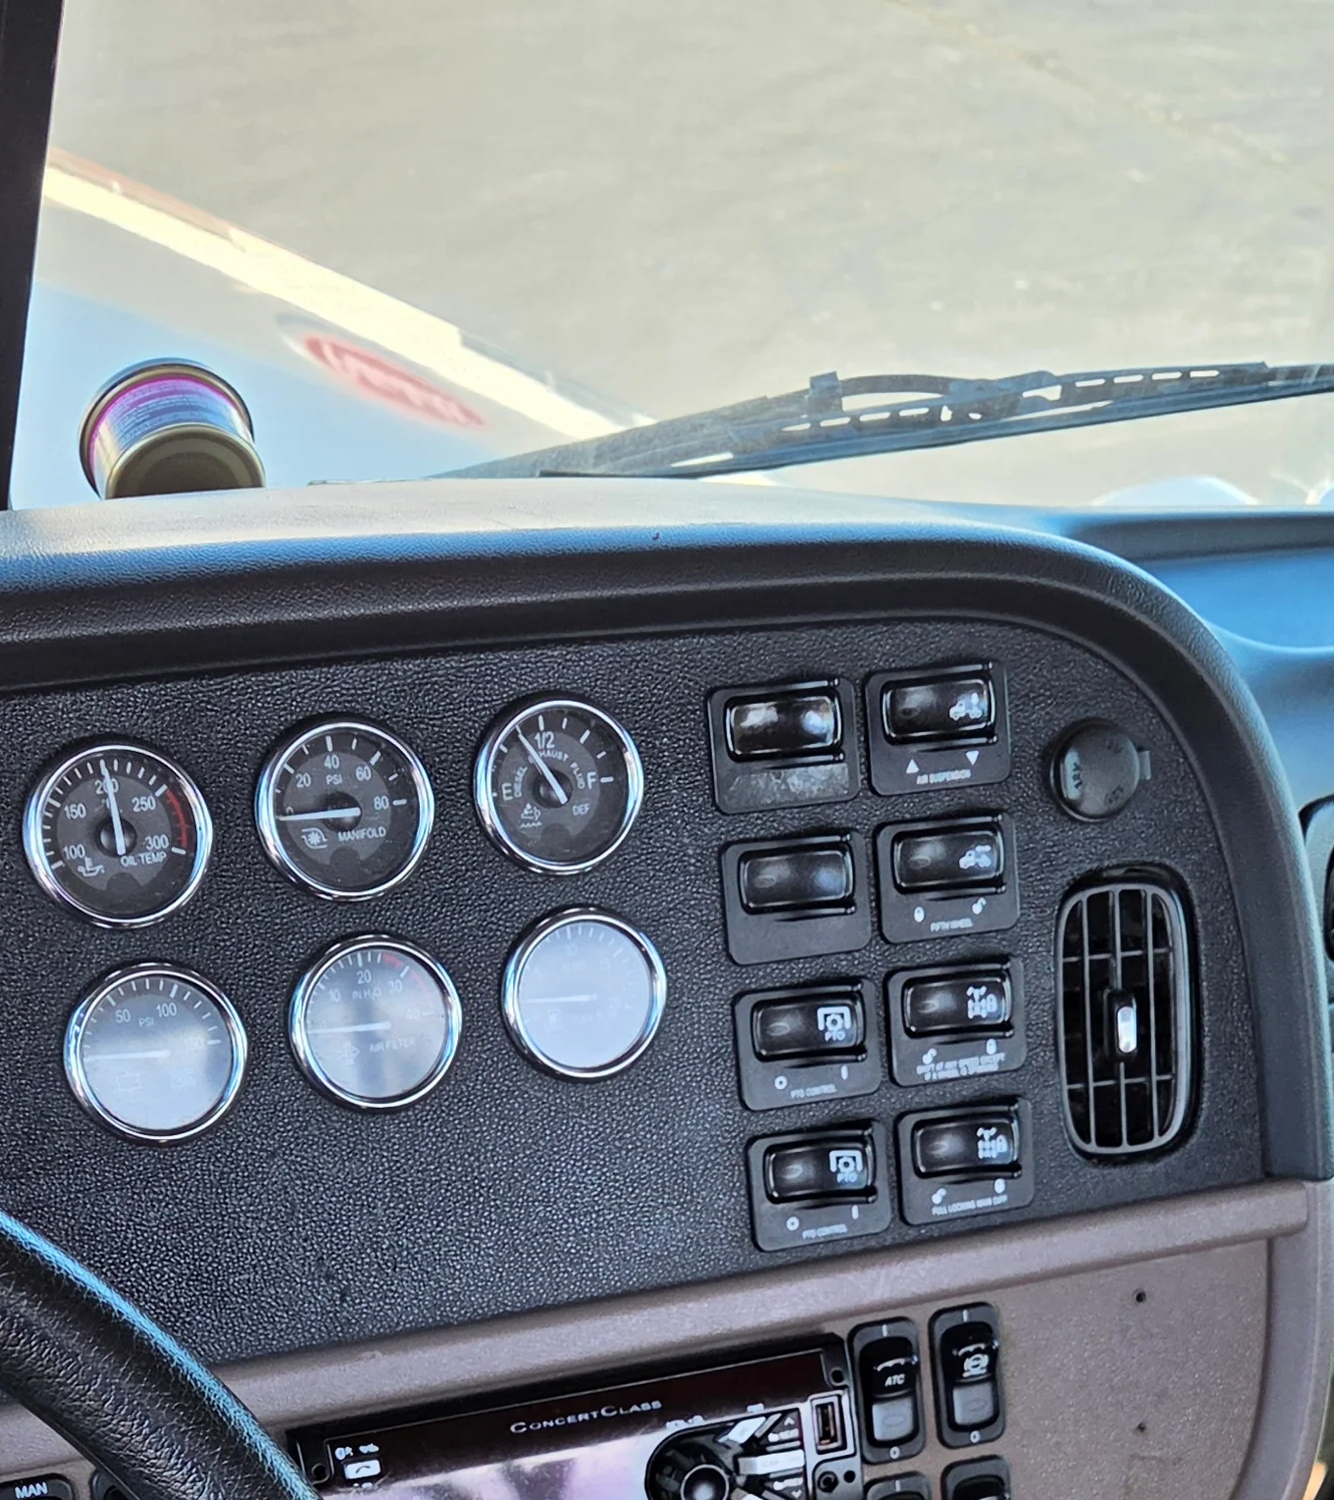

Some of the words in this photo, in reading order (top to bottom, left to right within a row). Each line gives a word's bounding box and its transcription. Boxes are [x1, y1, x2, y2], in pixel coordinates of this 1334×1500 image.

[324, 754, 340, 769] 40
[528, 750, 569, 764] EHAUST
[295, 772, 312, 789] 20
[326, 774, 343, 785] PSI
[355, 766, 372, 781] 60
[587, 771, 598, 790] F
[501, 782, 513, 801] E
[131, 795, 156, 812] 250
[374, 795, 390, 810] 80
[572, 803, 591, 816] DEF
[64, 803, 87, 819] 150
[144, 834, 170, 850] 300
[337, 826, 386, 842] MANIFOLD
[63, 844, 86, 860] 100
[120, 853, 138, 867] OIL
[139, 851, 167, 865] TEMP
[356, 969, 372, 985] 20
[115, 1008, 131, 1024] 50
[156, 1002, 177, 1018] 100
[885, 1374, 905, 1387] ATC
[15, 1482, 48, 1499] MAN
